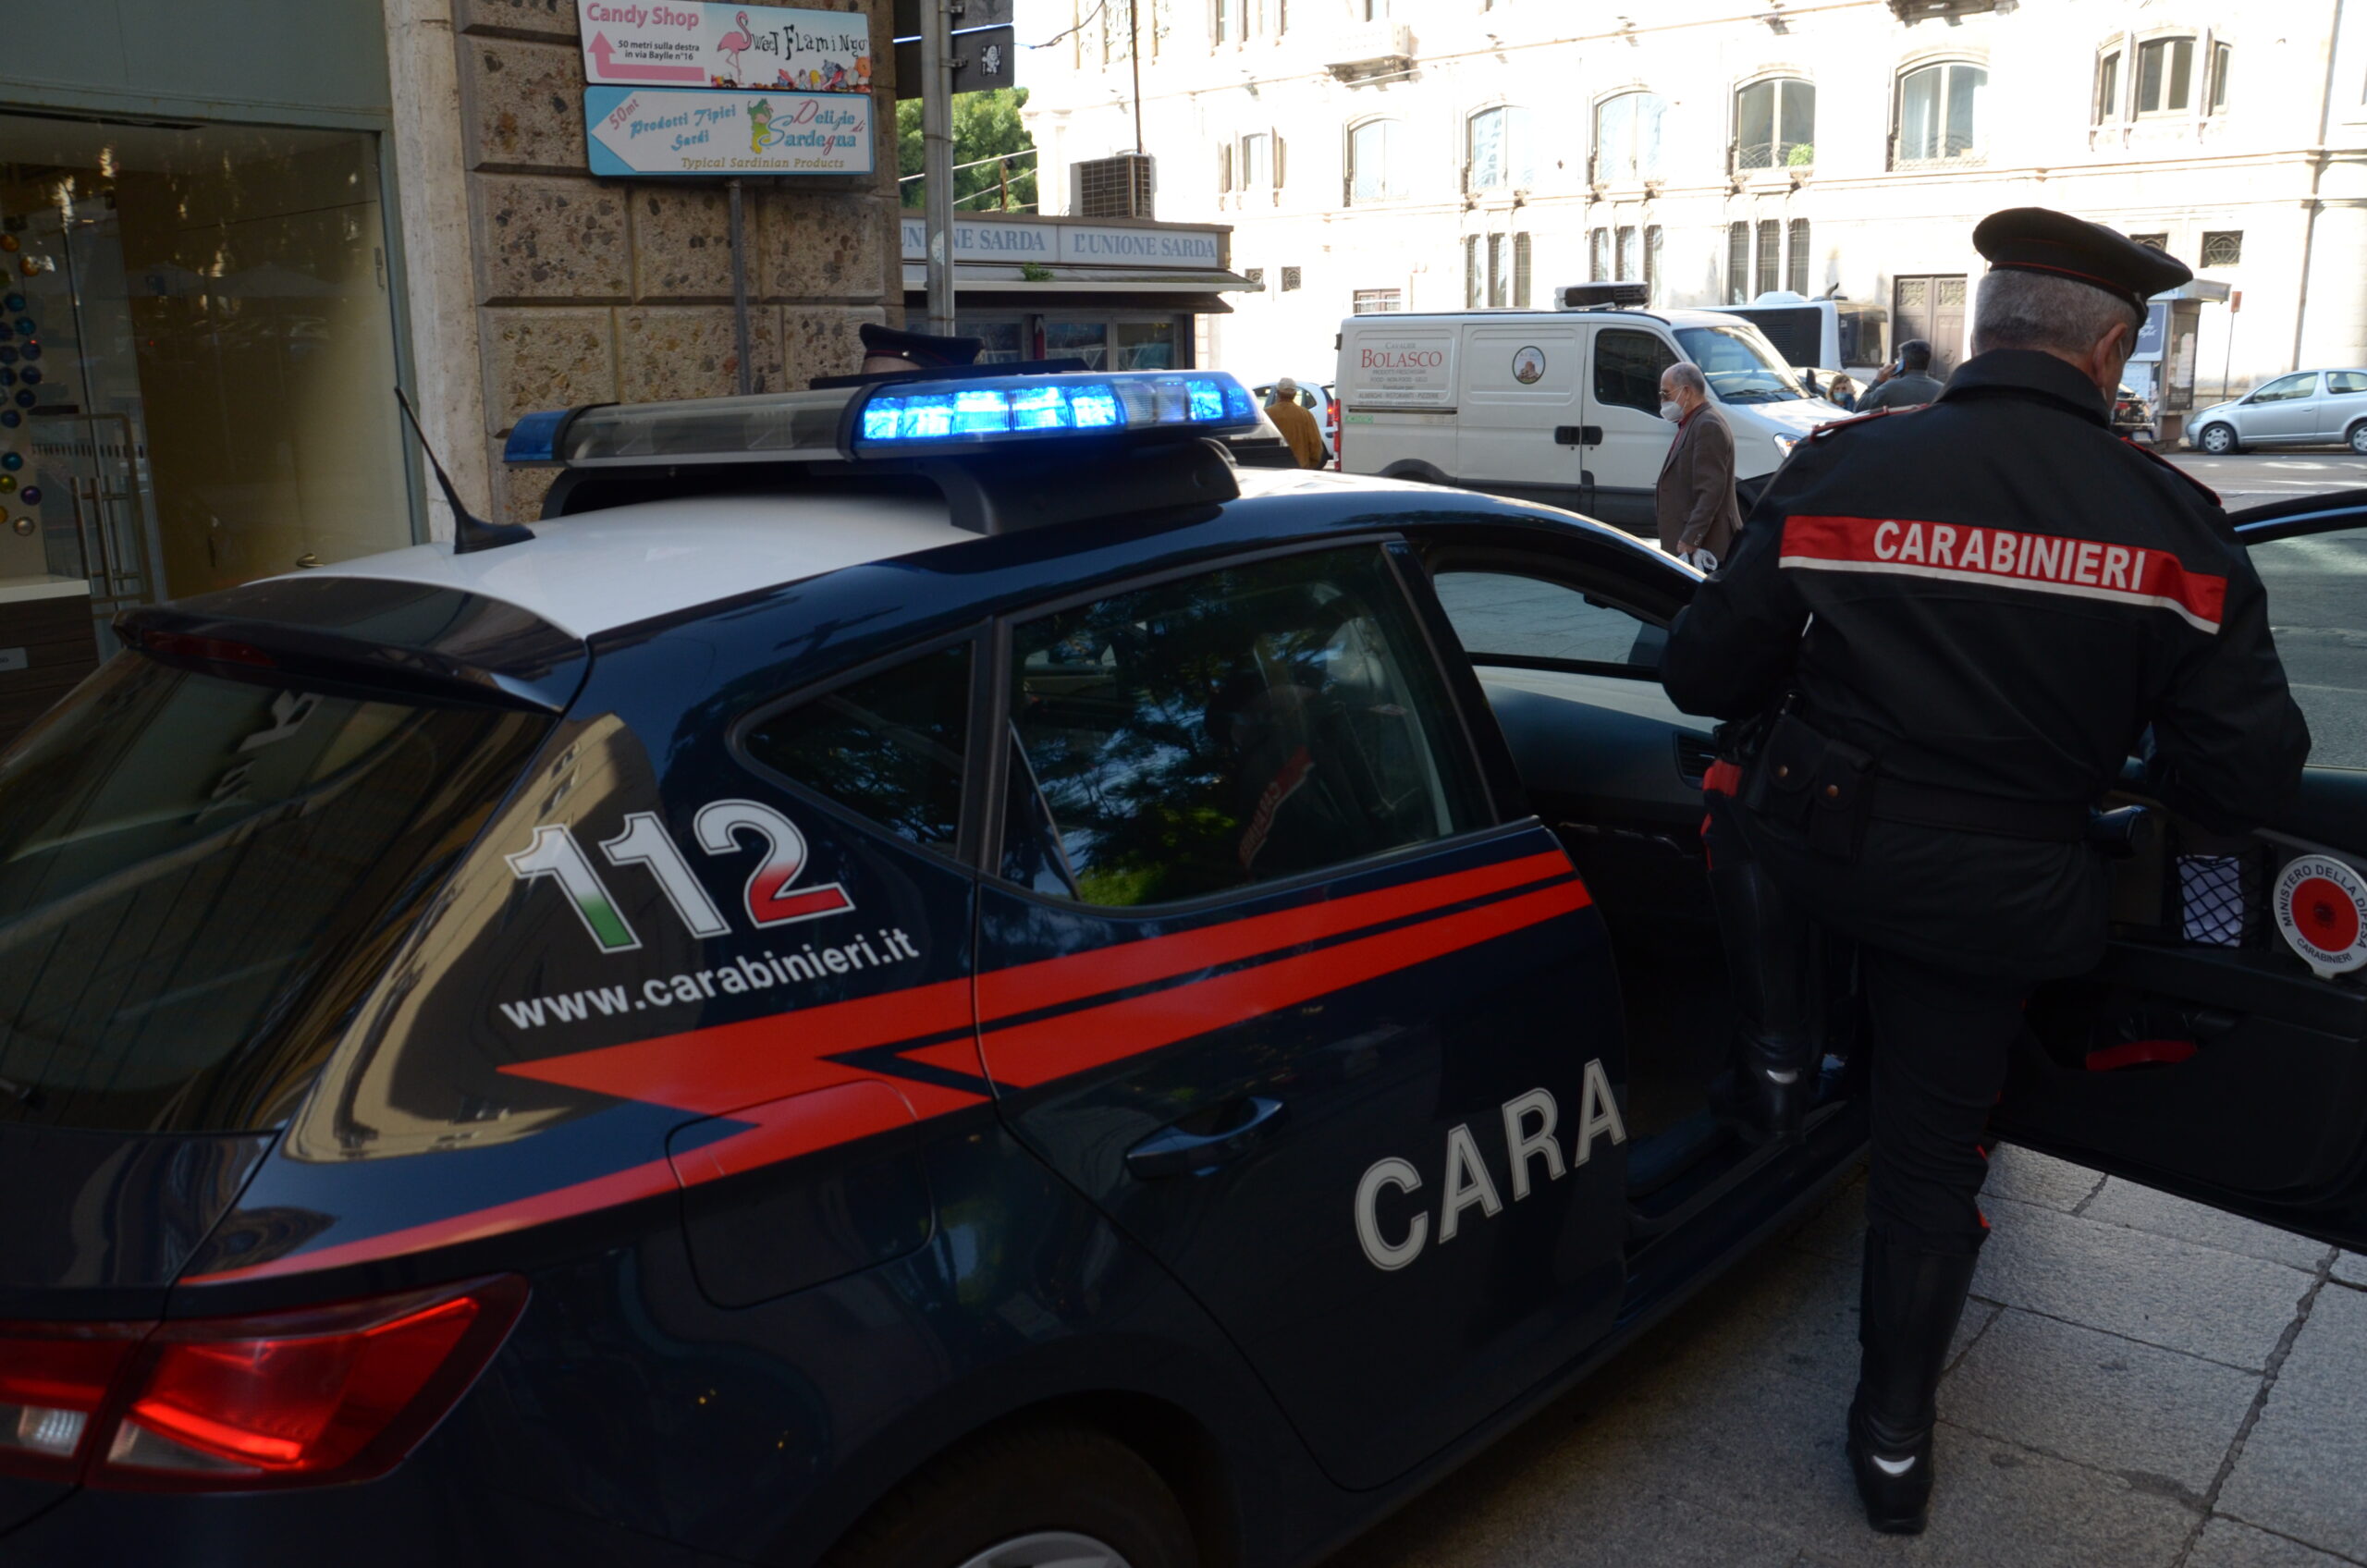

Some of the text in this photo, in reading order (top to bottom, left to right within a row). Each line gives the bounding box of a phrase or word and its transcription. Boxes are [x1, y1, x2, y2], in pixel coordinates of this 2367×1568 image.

[586, 2, 700, 31] Candy Shop
[618, 40, 700, 52] 50 metri sulla destra
[625, 50, 633, 58] in
[634, 51, 647, 59] via
[648, 51, 673, 61] Baylle
[608, 98, 640, 131] 50mt
[630, 104, 737, 140] Prodotti Tipici
[792, 99, 865, 132] Delizie di
[670, 129, 710, 152] Sardi
[758, 115, 857, 156] Sardegna
[681, 156, 845, 170] Typical Sardinian Products
[979, 228, 1047, 251] SARDA
[1073, 233, 1216, 258] L'UNIONE SARDA
[1361, 349, 1442, 368] BOLASCO
[1874, 521, 2145, 591] CARABINIERI
[504, 798, 856, 954] 112
[2279, 864, 2312, 927] MINISTERO
[2315, 864, 2357, 896] DELLA
[2297, 937, 2353, 963] CARABINIERI
[500, 927, 920, 1031] www.carabinieri.it
[1354, 1058, 1627, 1271] CARA
